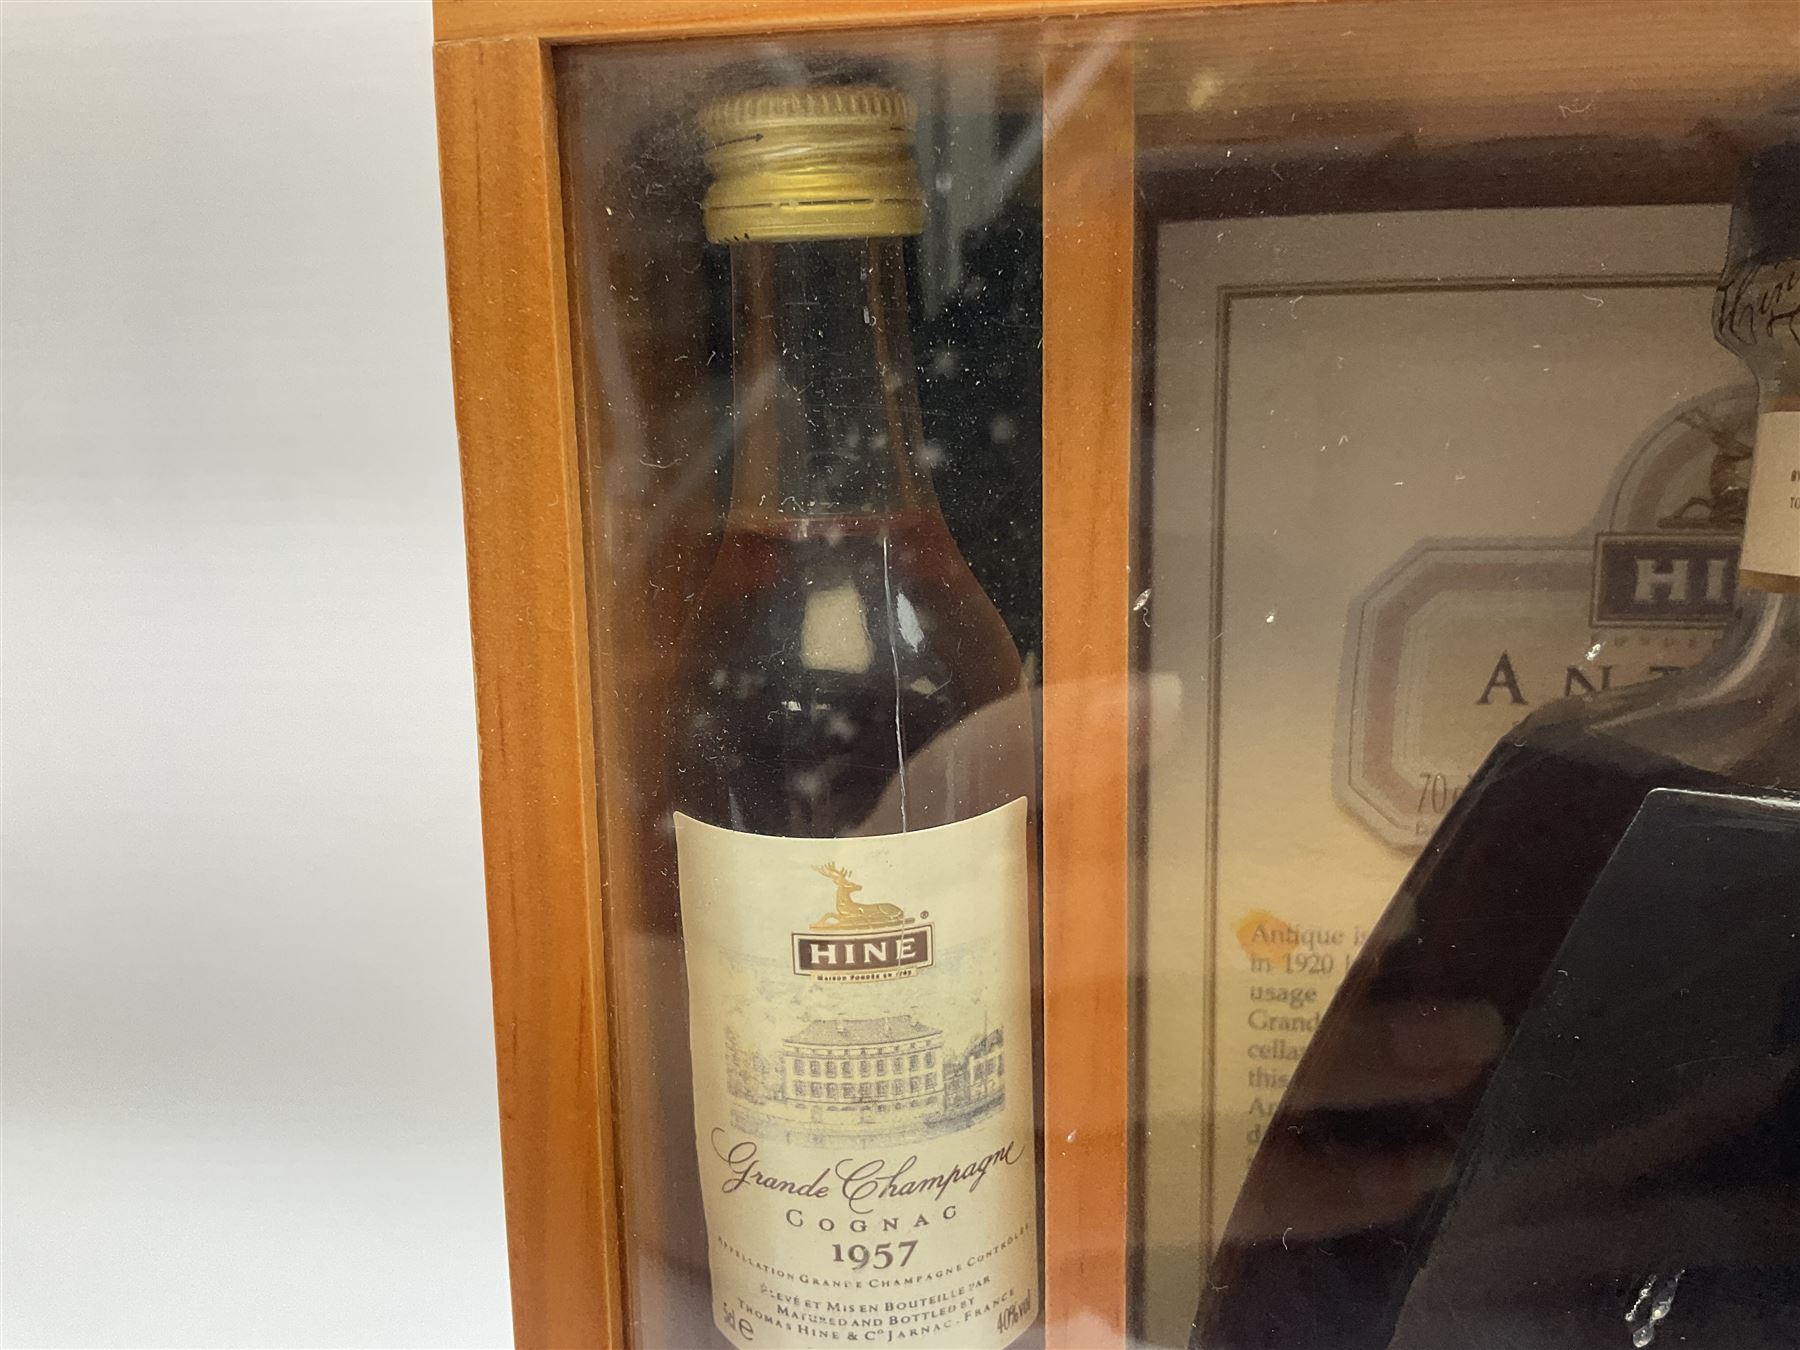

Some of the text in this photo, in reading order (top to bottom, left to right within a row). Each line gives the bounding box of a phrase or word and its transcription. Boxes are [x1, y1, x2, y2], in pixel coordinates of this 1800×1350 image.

[1634, 558, 1727, 601] HI
[810, 937, 916, 965] HINE
[1251, 923, 1345, 951] Antique
[1250, 953, 1271, 974] in
[1285, 952, 1334, 975] 1920
[1250, 985, 1318, 1009] usage
[1247, 1009, 1321, 1032] Grand
[1247, 1039, 1301, 1061] cella
[711, 1127, 1027, 1214] Grande Champagne
[786, 1205, 957, 1233] COGNAC
[832, 1240, 919, 1271] 1957
[799, 1274, 862, 1289] GRANDE
[868, 1263, 962, 1289] CHAMPAGNE
[851, 1318, 883, 1327] AND
[889, 1304, 957, 1326] BOTTLED
[960, 1296, 976, 1310] BY
[860, 1304, 879, 1313] EN
[884, 1286, 966, 1312] BOUTEILLE
[737, 1297, 792, 1331] THOMAS
[798, 1324, 840, 1340] HINE
[847, 1330, 858, 1341] &
[888, 1319, 952, 1343] JARNAC
[964, 1288, 1015, 1322] FRANCE
